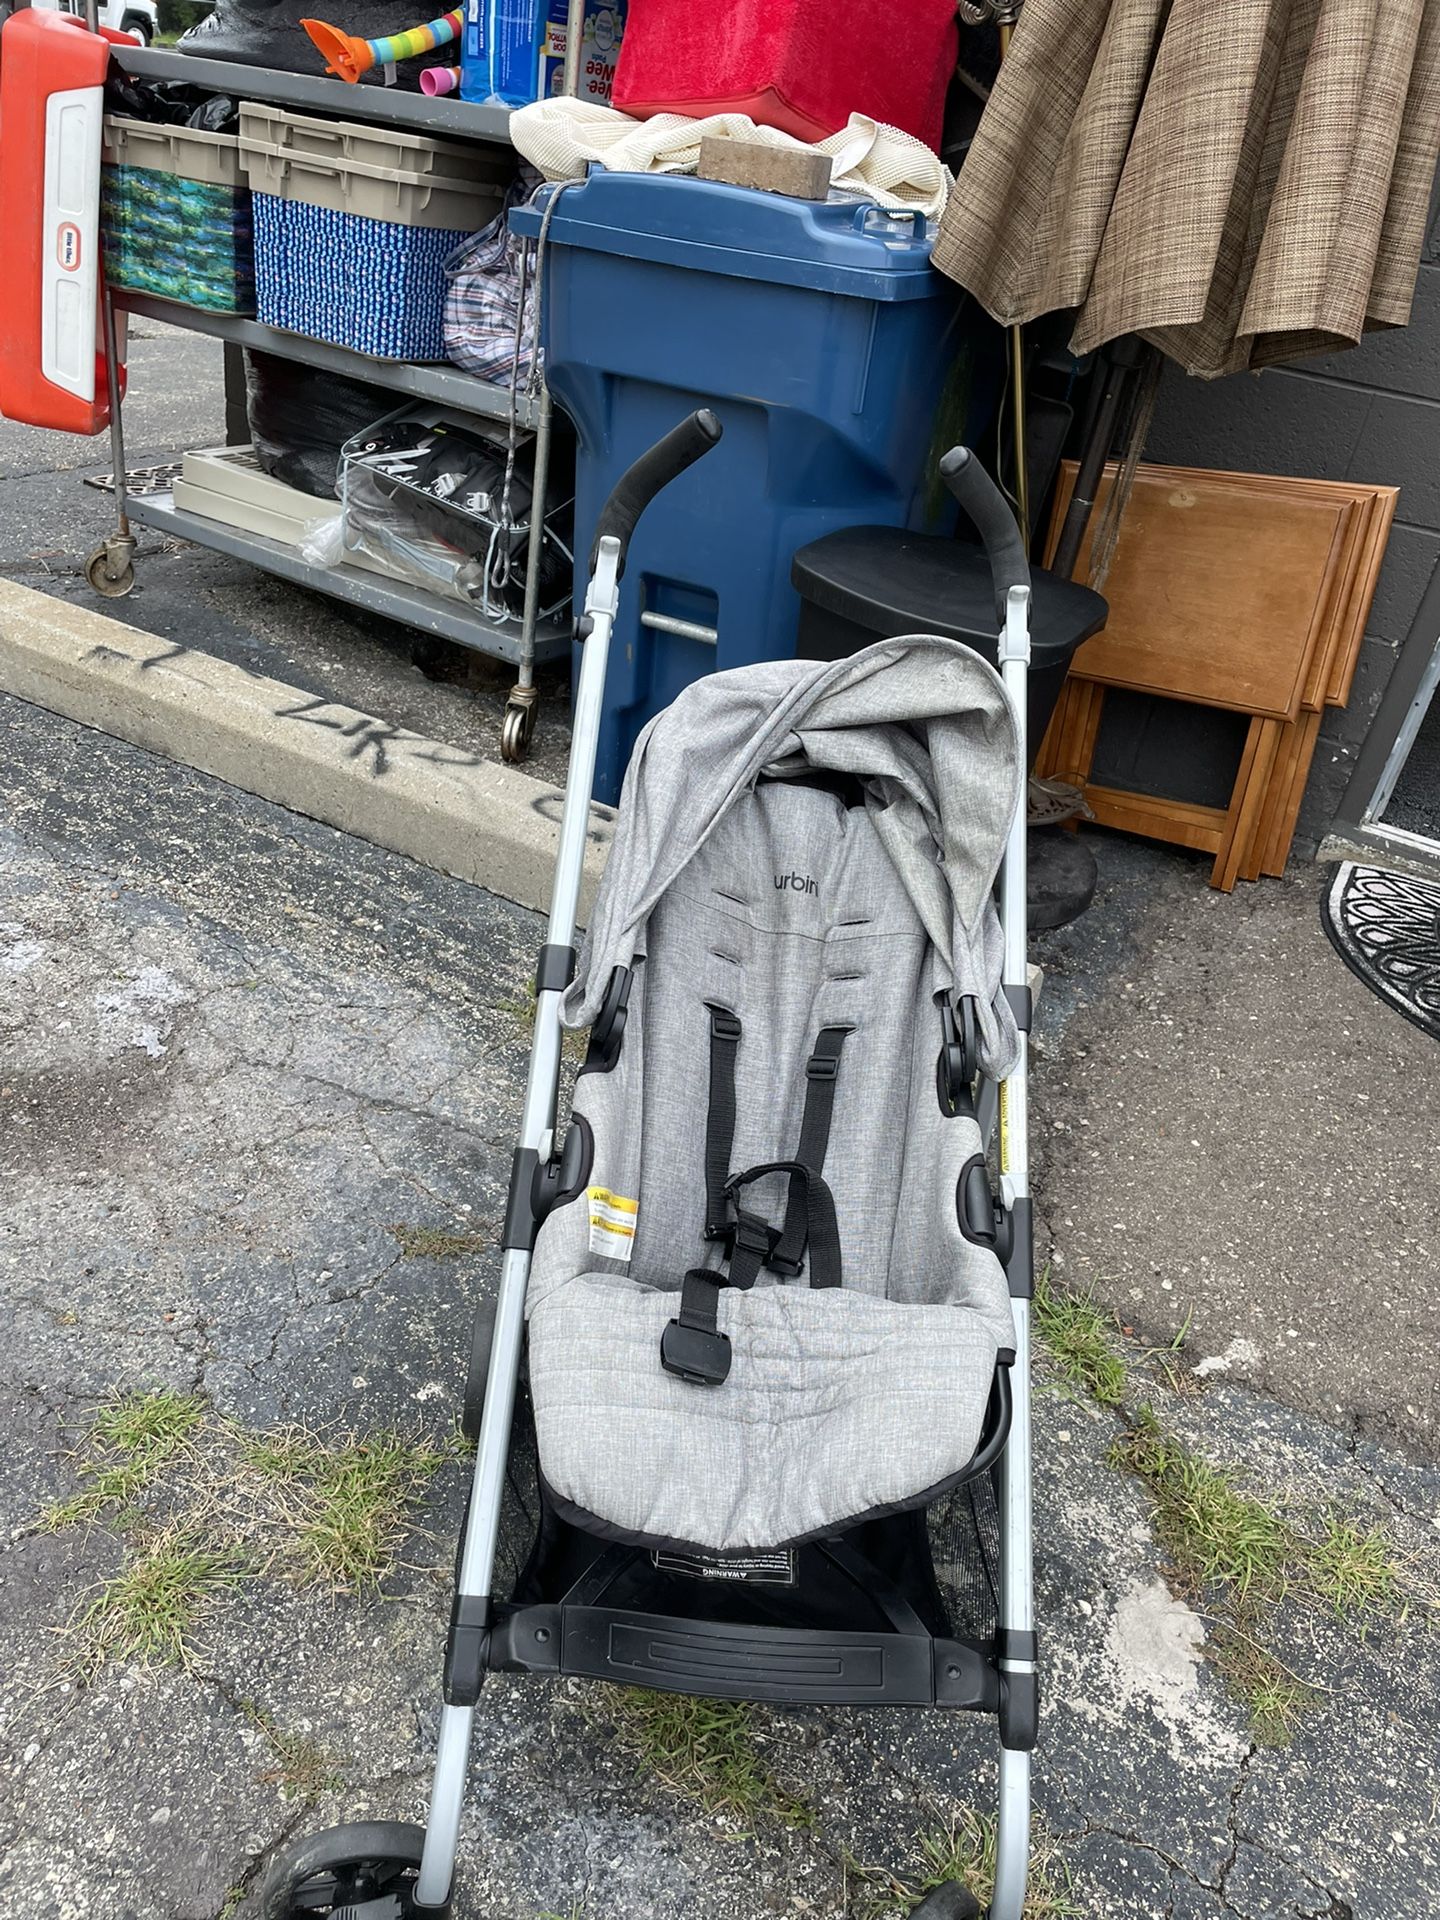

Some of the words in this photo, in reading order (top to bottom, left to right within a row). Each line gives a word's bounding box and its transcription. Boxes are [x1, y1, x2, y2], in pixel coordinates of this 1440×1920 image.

[547, 32, 567, 43] NTROL
[553, 42, 567, 52] DOR
[585, 60, 615, 81] Wee
[702, 1568, 740, 1578] WARNING
